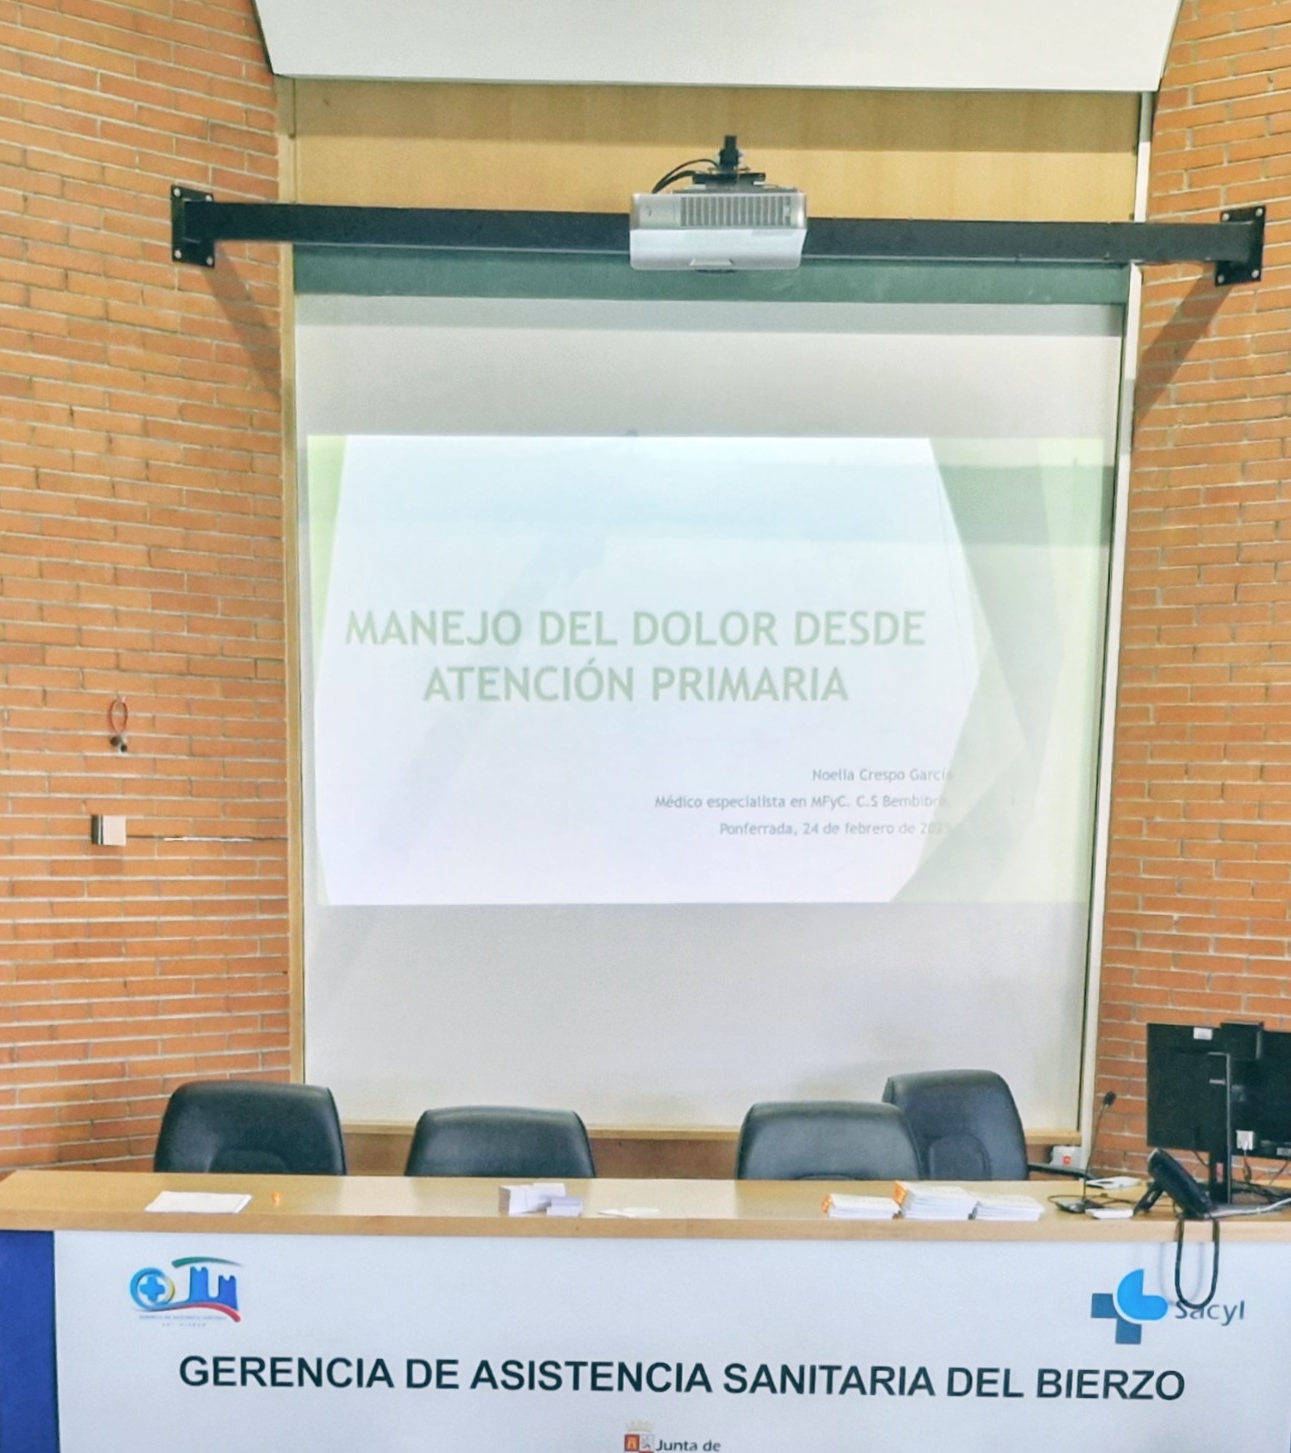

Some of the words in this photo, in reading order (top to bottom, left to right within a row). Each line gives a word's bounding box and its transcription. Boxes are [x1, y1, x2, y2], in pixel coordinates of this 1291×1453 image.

[344, 609, 523, 647] MANEJO
[539, 610, 618, 647] DEL
[632, 610, 778, 647] DOLOR
[794, 610, 926, 647] DESDE
[423, 657, 634, 702] ATENCIÓN
[652, 666, 849, 702] PRIMARIA
[812, 769, 855, 782] Noelia
[859, 769, 906, 784] Crespo
[655, 794, 703, 808] Médico
[707, 795, 786, 811] especialista
[790, 798, 807, 808] en
[719, 822, 798, 837] Ponferrada,
[803, 822, 819, 835] 24
[823, 822, 840, 835] de
[844, 822, 895, 835] febrero
[898, 822, 916, 835] de
[920, 822, 950, 835] 202
[179, 1355, 395, 1388] GERENCIA
[406, 1358, 460, 1390] DE
[470, 1359, 713, 1393] ASISTENCIA
[723, 1362, 936, 1396] SANITARIA
[947, 1367, 1024, 1398] DEL
[1036, 1368, 1185, 1401] BIERZO
[655, 1439, 698, 1452] Junta
[702, 1439, 722, 1452] de
